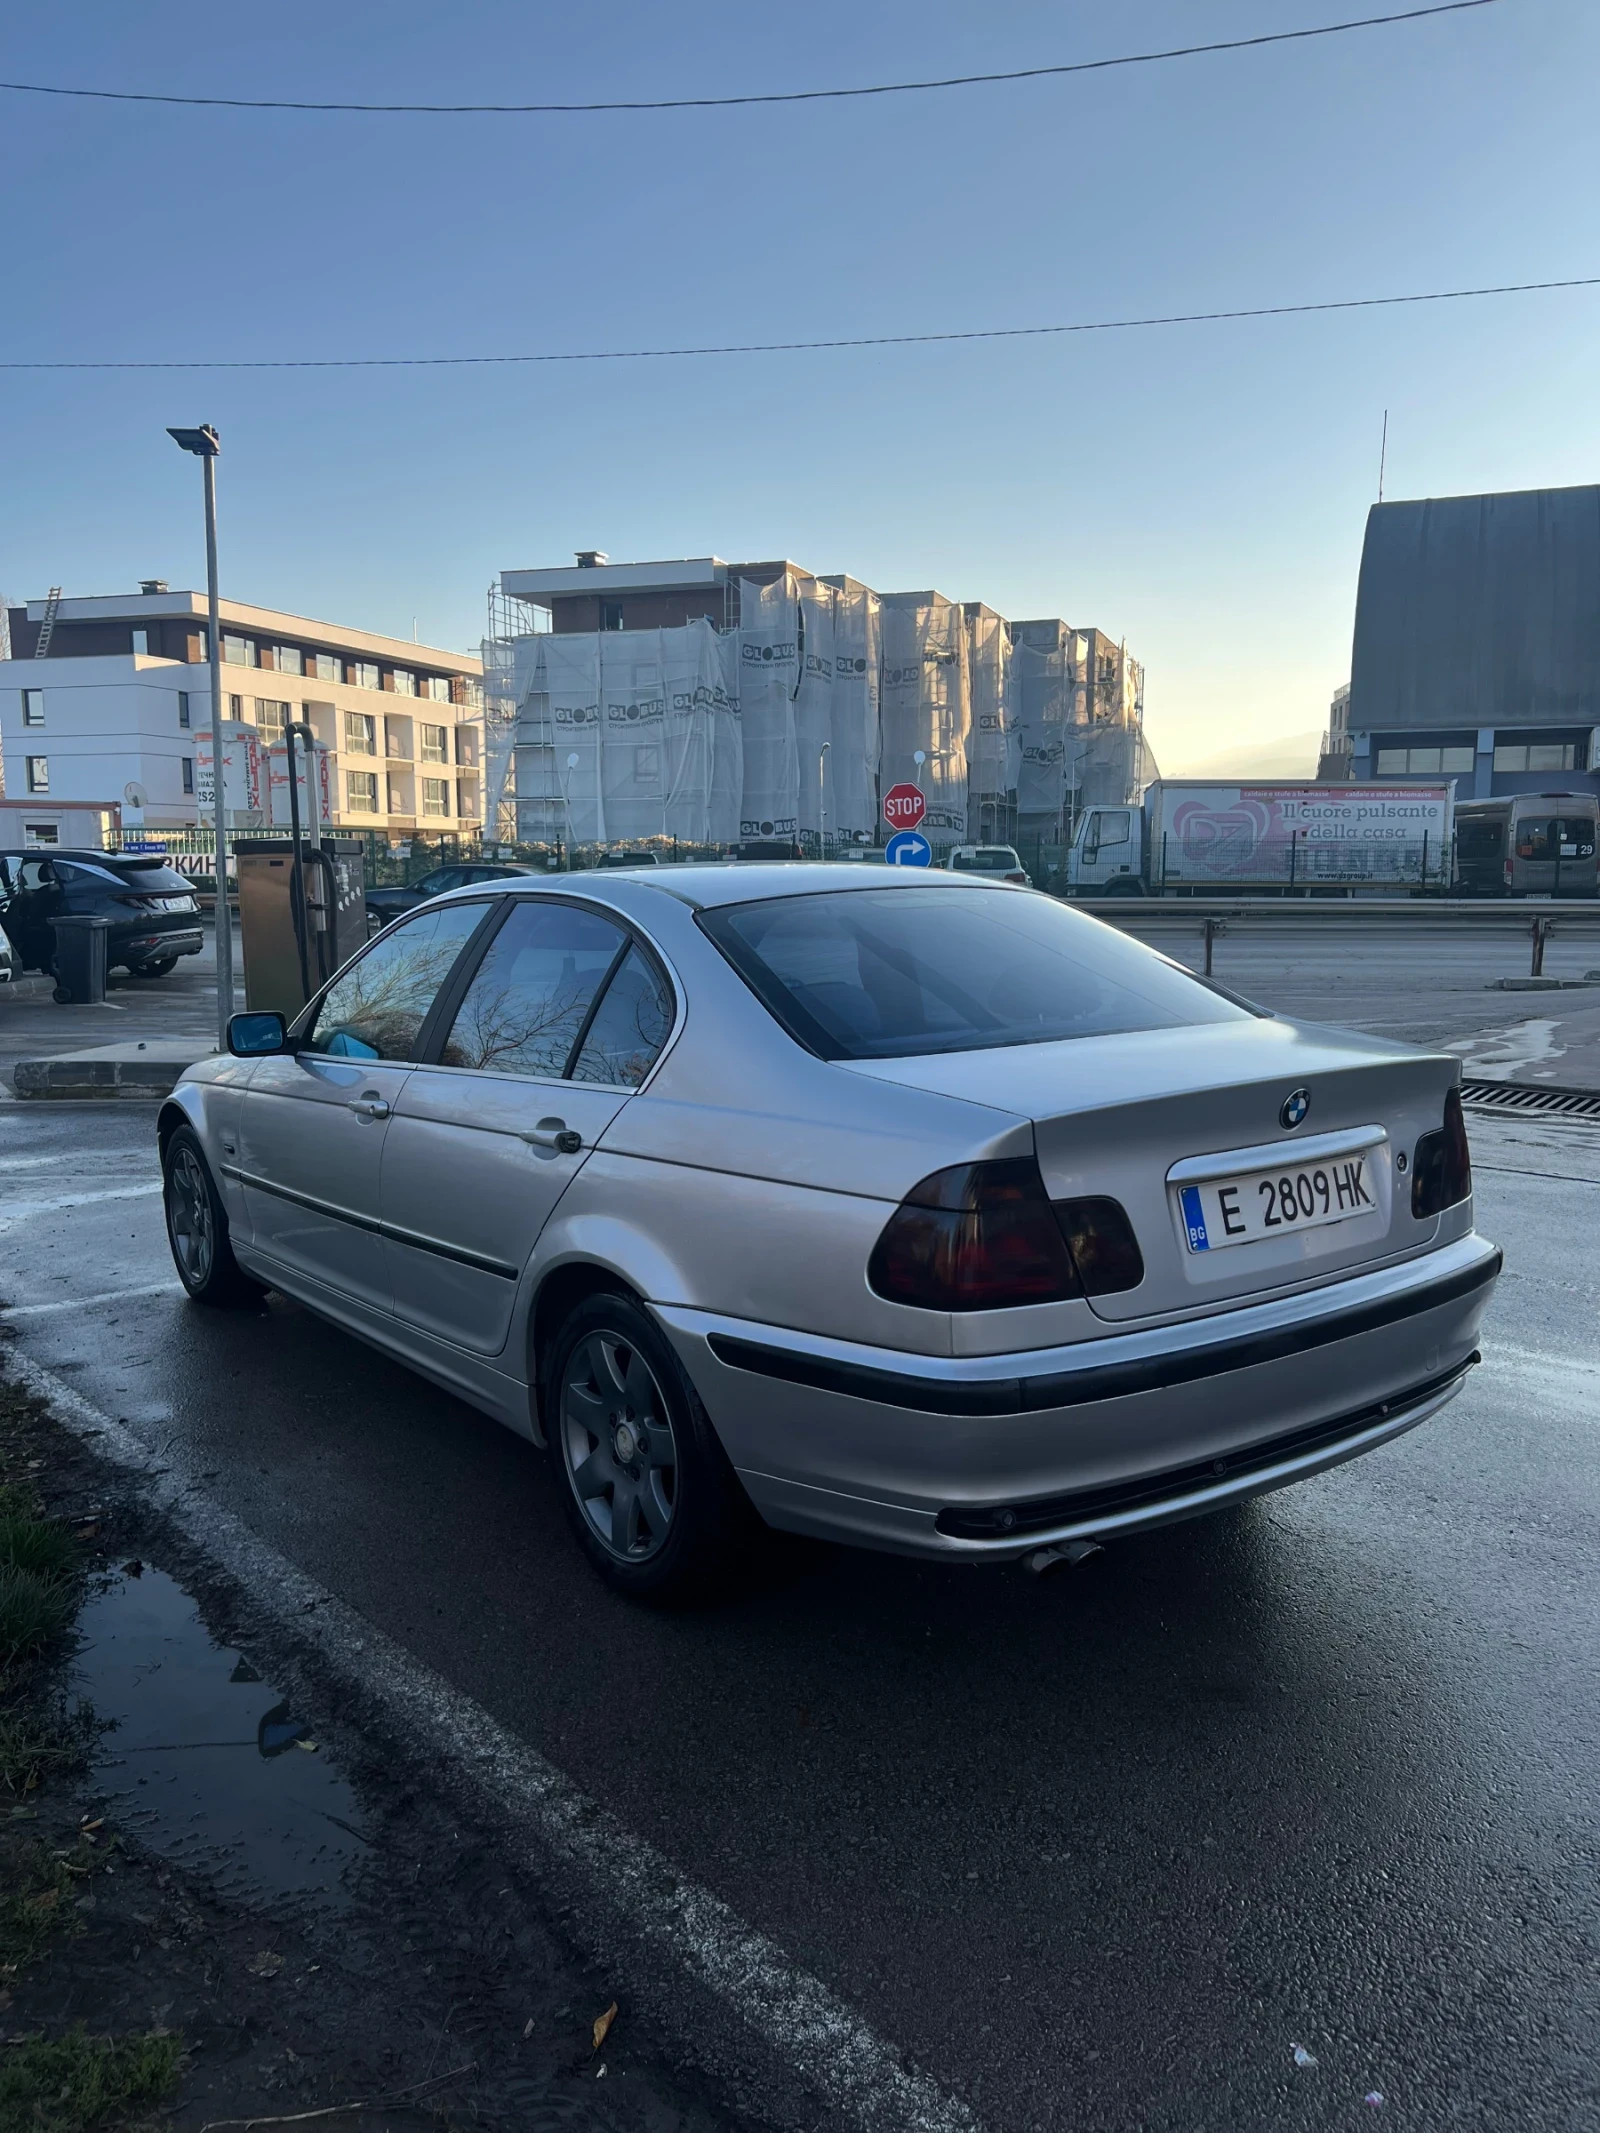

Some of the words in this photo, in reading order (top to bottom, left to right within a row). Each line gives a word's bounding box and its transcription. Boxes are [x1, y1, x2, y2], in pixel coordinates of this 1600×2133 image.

[741, 643, 795, 661] GLOBUS
[608, 699, 664, 721] GLOBUS
[1243, 790, 1268, 798] caldaie
[1297, 790, 1330, 798] biomasse
[1345, 790, 1370, 798] caldaie
[1376, 790, 1393, 798] stufe
[1400, 790, 1432, 798] biomasse
[886, 796, 922, 816] STOP
[1283, 803, 1296, 818] Il
[1301, 808, 1352, 818] cuore
[1356, 803, 1438, 821] pulsante
[740, 818, 797, 837] GLOBUS
[1310, 824, 1358, 838] della
[1363, 828, 1407, 838] casa
[1580, 845, 1593, 855] 29
[1217, 1186, 1247, 1236] E
[1189, 1226, 1206, 1242] BG
